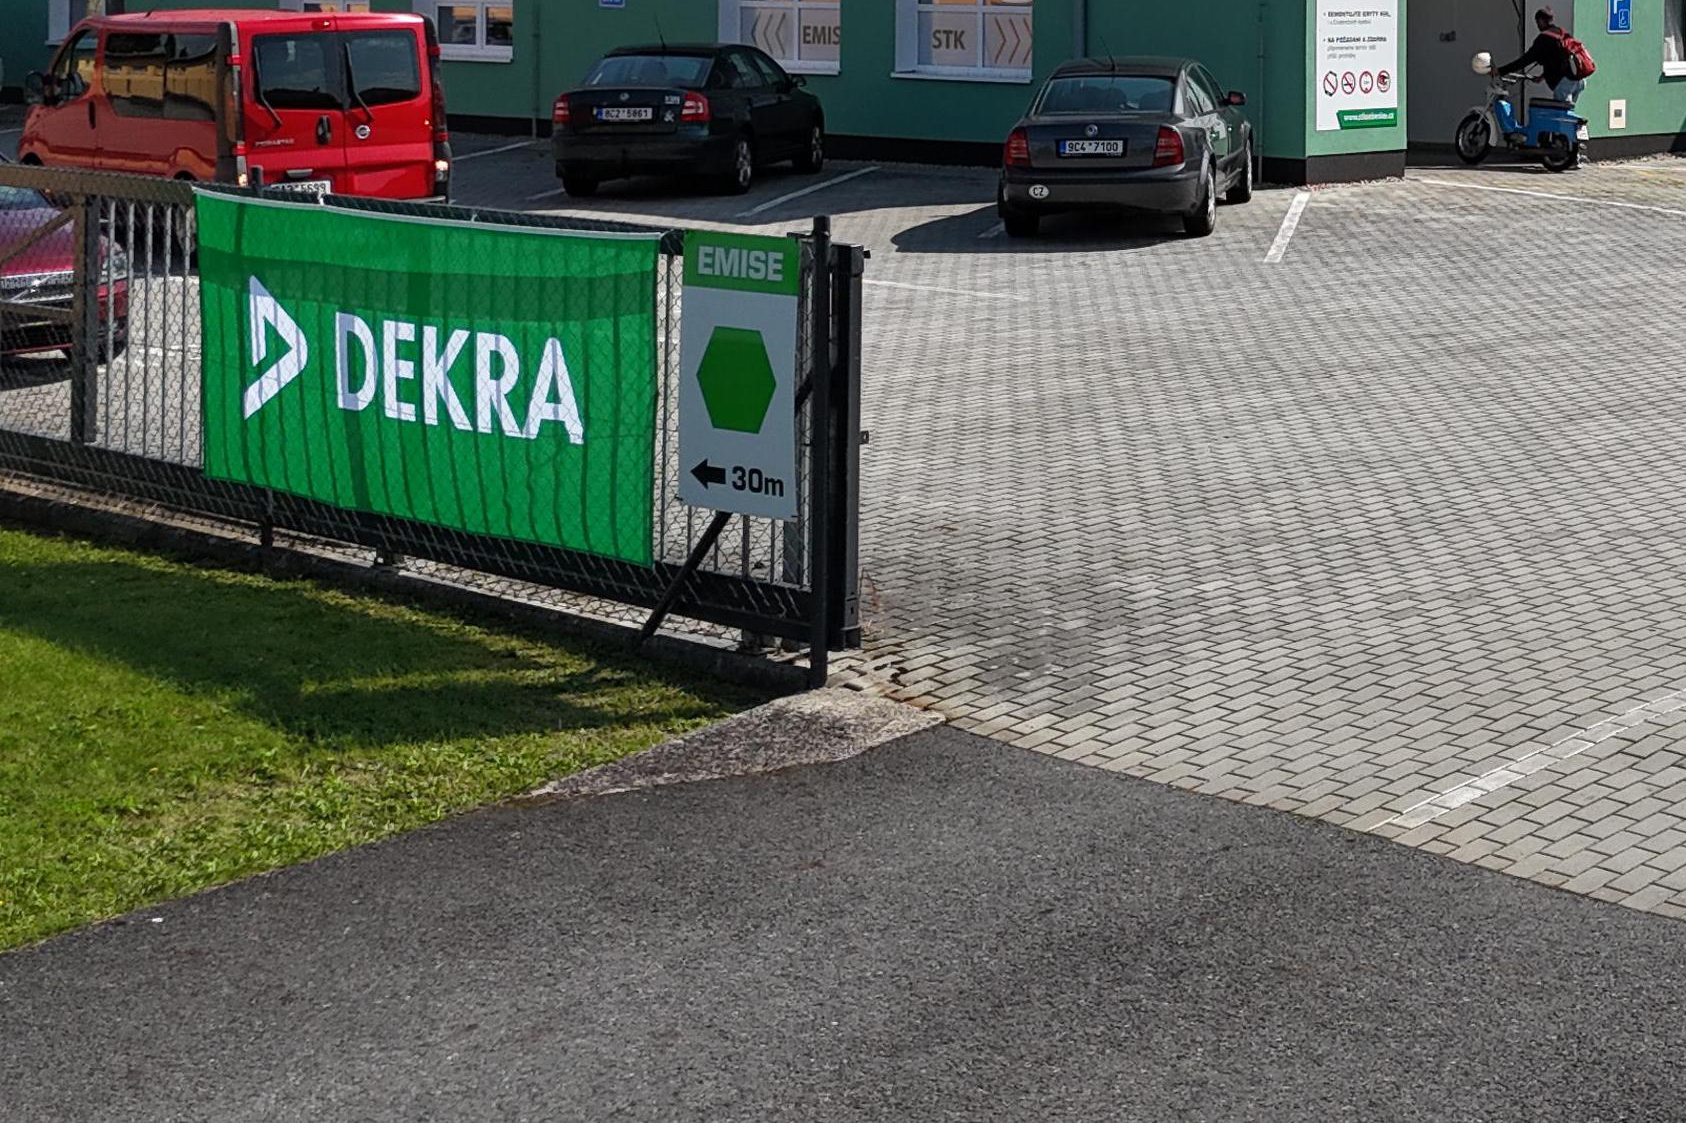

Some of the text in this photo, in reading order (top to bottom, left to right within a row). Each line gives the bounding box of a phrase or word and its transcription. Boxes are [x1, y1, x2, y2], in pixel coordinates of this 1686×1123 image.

[802, 25, 840, 46] EMIS
[932, 29, 966, 50] STK
[1067, 142, 1119, 152] 9C4 7100
[1032, 187, 1044, 197] CZ
[698, 245, 784, 282] EMISE
[334, 310, 585, 445] DEKRA
[731, 465, 785, 497] 30m
